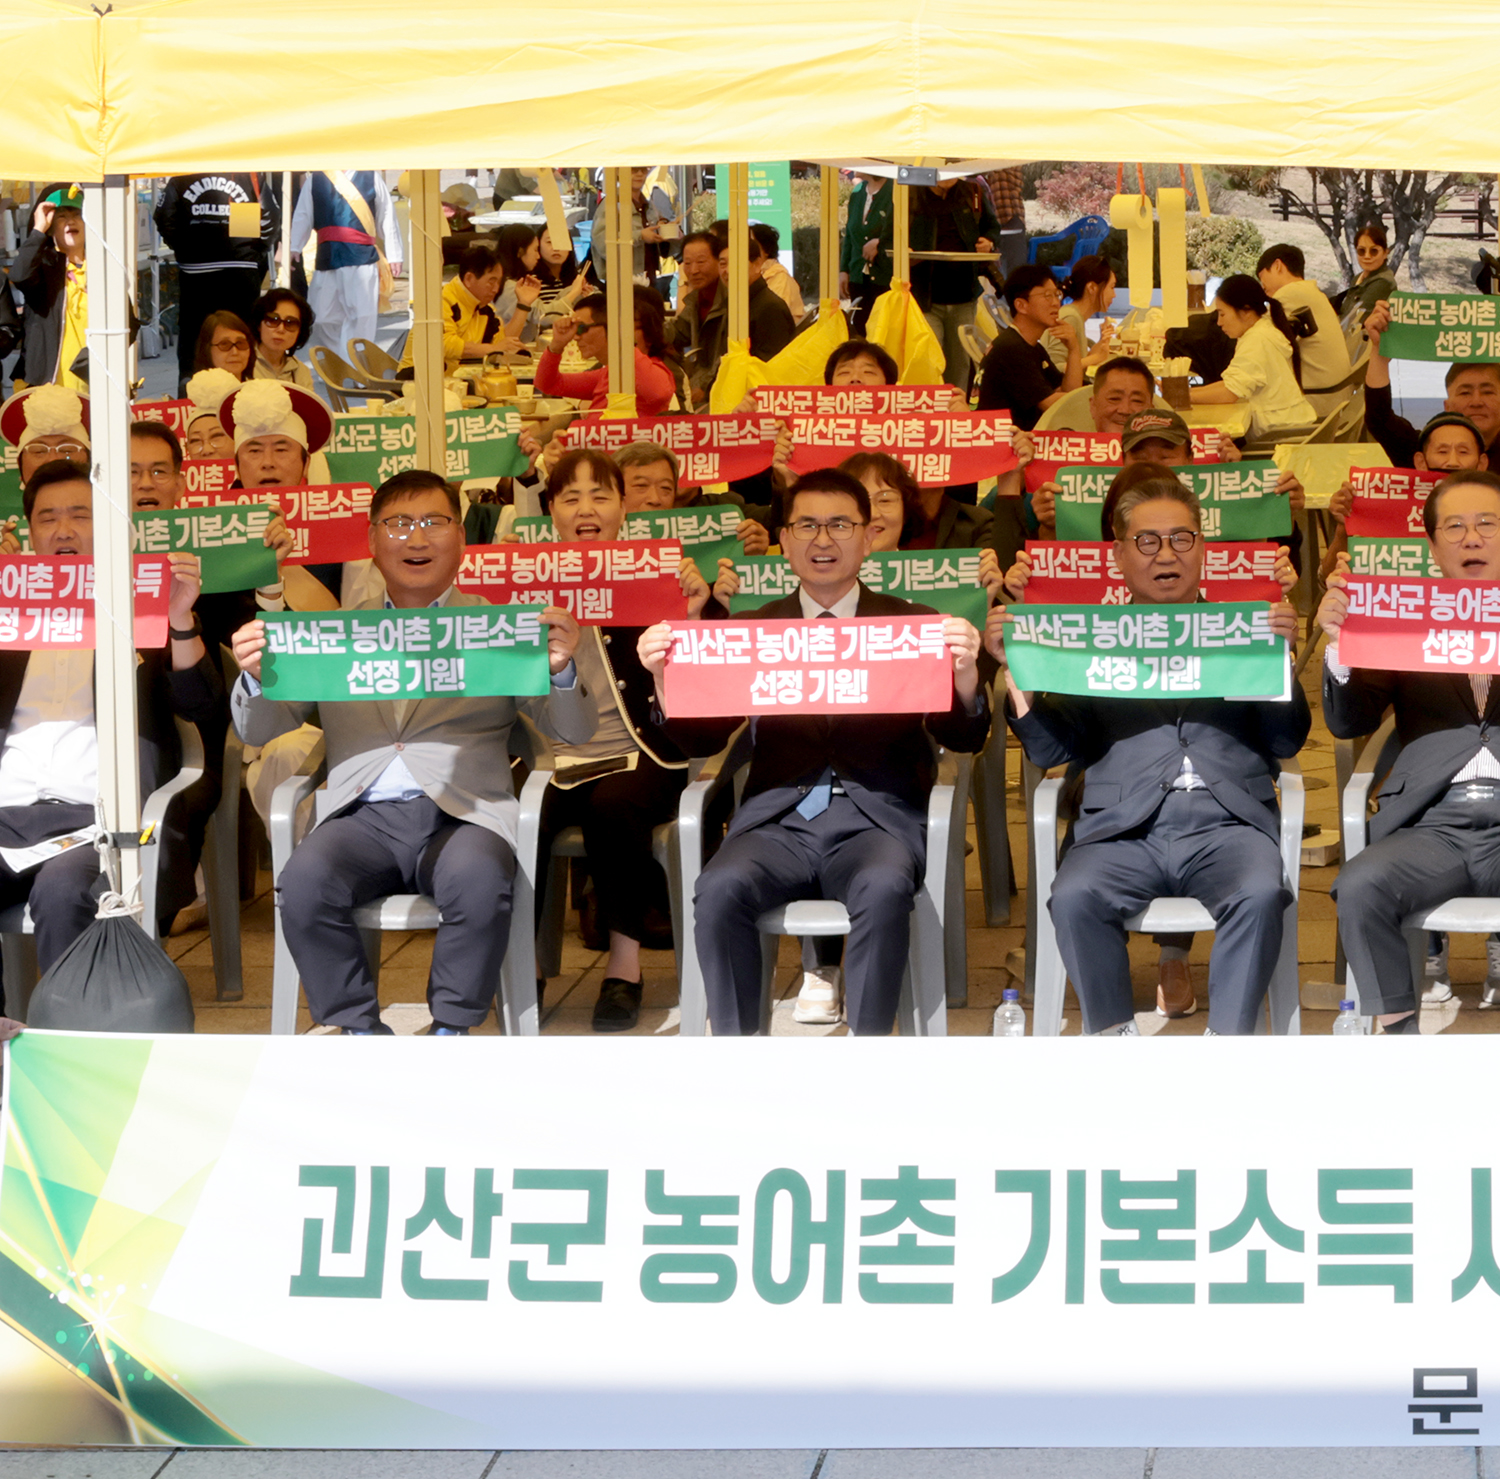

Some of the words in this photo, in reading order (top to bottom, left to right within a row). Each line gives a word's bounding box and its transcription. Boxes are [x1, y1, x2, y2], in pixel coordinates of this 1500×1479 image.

[183, 176, 249, 203] ENDICOTT
[1389, 298, 1436, 325] 괴산군
[1440, 300, 1496, 327] 농어촌
[1434, 332, 1472, 357] 선정
[755, 391, 812, 416] 괴산군
[816, 390, 874, 414] 농어촌
[877, 390, 953, 414] 기본소득
[380, 423, 417, 450] 농어
[445, 412, 521, 443] 기본소득
[566, 425, 627, 450] 괴산군
[632, 421, 694, 449] 농어촌
[698, 418, 779, 447] 기본소득
[792, 418, 856, 446] 괴산군
[860, 418, 925, 448] 농어촌
[930, 418, 1013, 447] 기본소득
[445, 449, 470, 477] 원!
[1032, 437, 1086, 462] 괴산군
[1090, 437, 1123, 462] 농어
[183, 464, 224, 491] 어촌
[902, 454, 951, 482] 기원!
[1199, 468, 1282, 501] 기본소득
[1351, 472, 1409, 500] 괴산군
[286, 487, 373, 521] 기본소득
[176, 511, 271, 549] 기본소득
[656, 511, 741, 545] 기본소득
[1200, 508, 1221, 537] 원!
[454, 552, 506, 585] 산군
[511, 549, 583, 584] 농어촌
[588, 547, 681, 580] 기본소득
[888, 557, 981, 591] 기본소득
[1031, 548, 1101, 579] 괴산군
[1199, 549, 1276, 581] 본소득
[1352, 546, 1423, 577] 괴산군
[0, 562, 54, 599] 어촌
[559, 588, 613, 619] 기원!
[1346, 582, 1425, 619] 괴산군
[24, 606, 84, 643] 기원!
[266, 620, 346, 654] 괴산군
[351, 617, 432, 654] 농어촌
[437, 611, 541, 650] 기본소득
[1012, 614, 1087, 649] 괴산군
[1092, 613, 1169, 649] 농어촌
[1174, 611, 1276, 648] 기본소득
[672, 628, 751, 665] 괴산군
[755, 624, 836, 663] 농어촌
[841, 622, 945, 661] 기본소득
[1422, 629, 1474, 665] 선정
[346, 659, 400, 695] 선정
[405, 657, 466, 694] 기원!
[750, 669, 802, 706] 선정
[809, 668, 868, 704] 기원!
[1086, 656, 1137, 691] 선정
[1143, 655, 1201, 691] 기원!
[289, 1164, 608, 1302] 괴산군
[639, 1165, 957, 1304] 농어촌
[990, 1168, 1414, 1305] 기본소득
